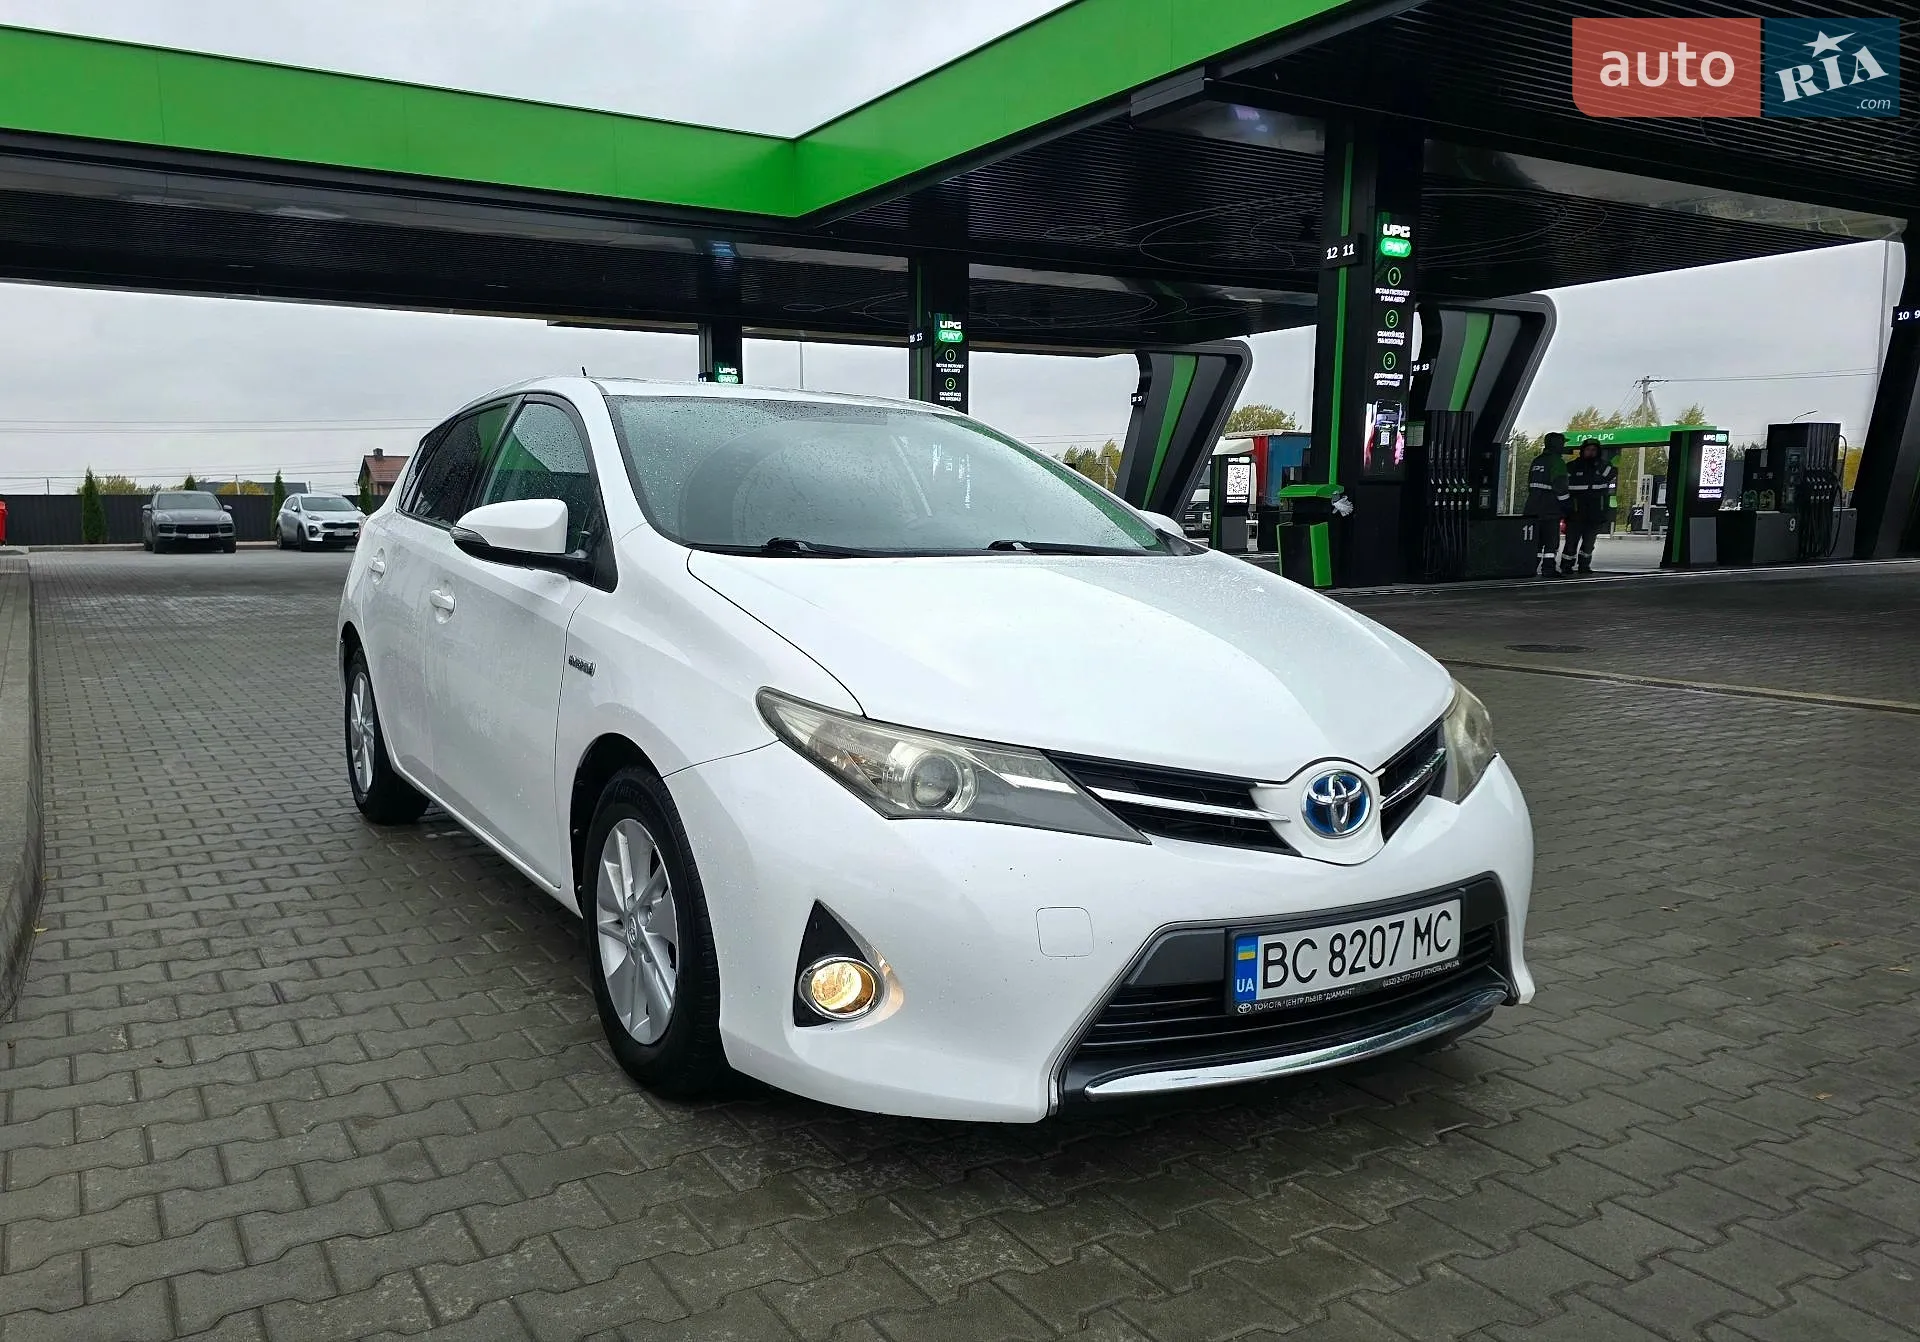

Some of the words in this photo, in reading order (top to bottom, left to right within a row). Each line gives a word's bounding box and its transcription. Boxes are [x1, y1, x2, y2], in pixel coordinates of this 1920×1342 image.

[1382, 224, 1410, 238] UPG
[1326, 246, 1338, 260] 12
[1342, 243, 1355, 257] 11
[1384, 240, 1408, 254] PAY
[1898, 311, 1910, 320] 10
[940, 321, 961, 329] UPG
[1789, 518, 1796, 531] 9
[1522, 525, 1534, 541] 11
[1262, 938, 1318, 989] BC
[1328, 920, 1405, 978] 8207
[1413, 910, 1452, 960] MC
[1236, 978, 1254, 993] UA
